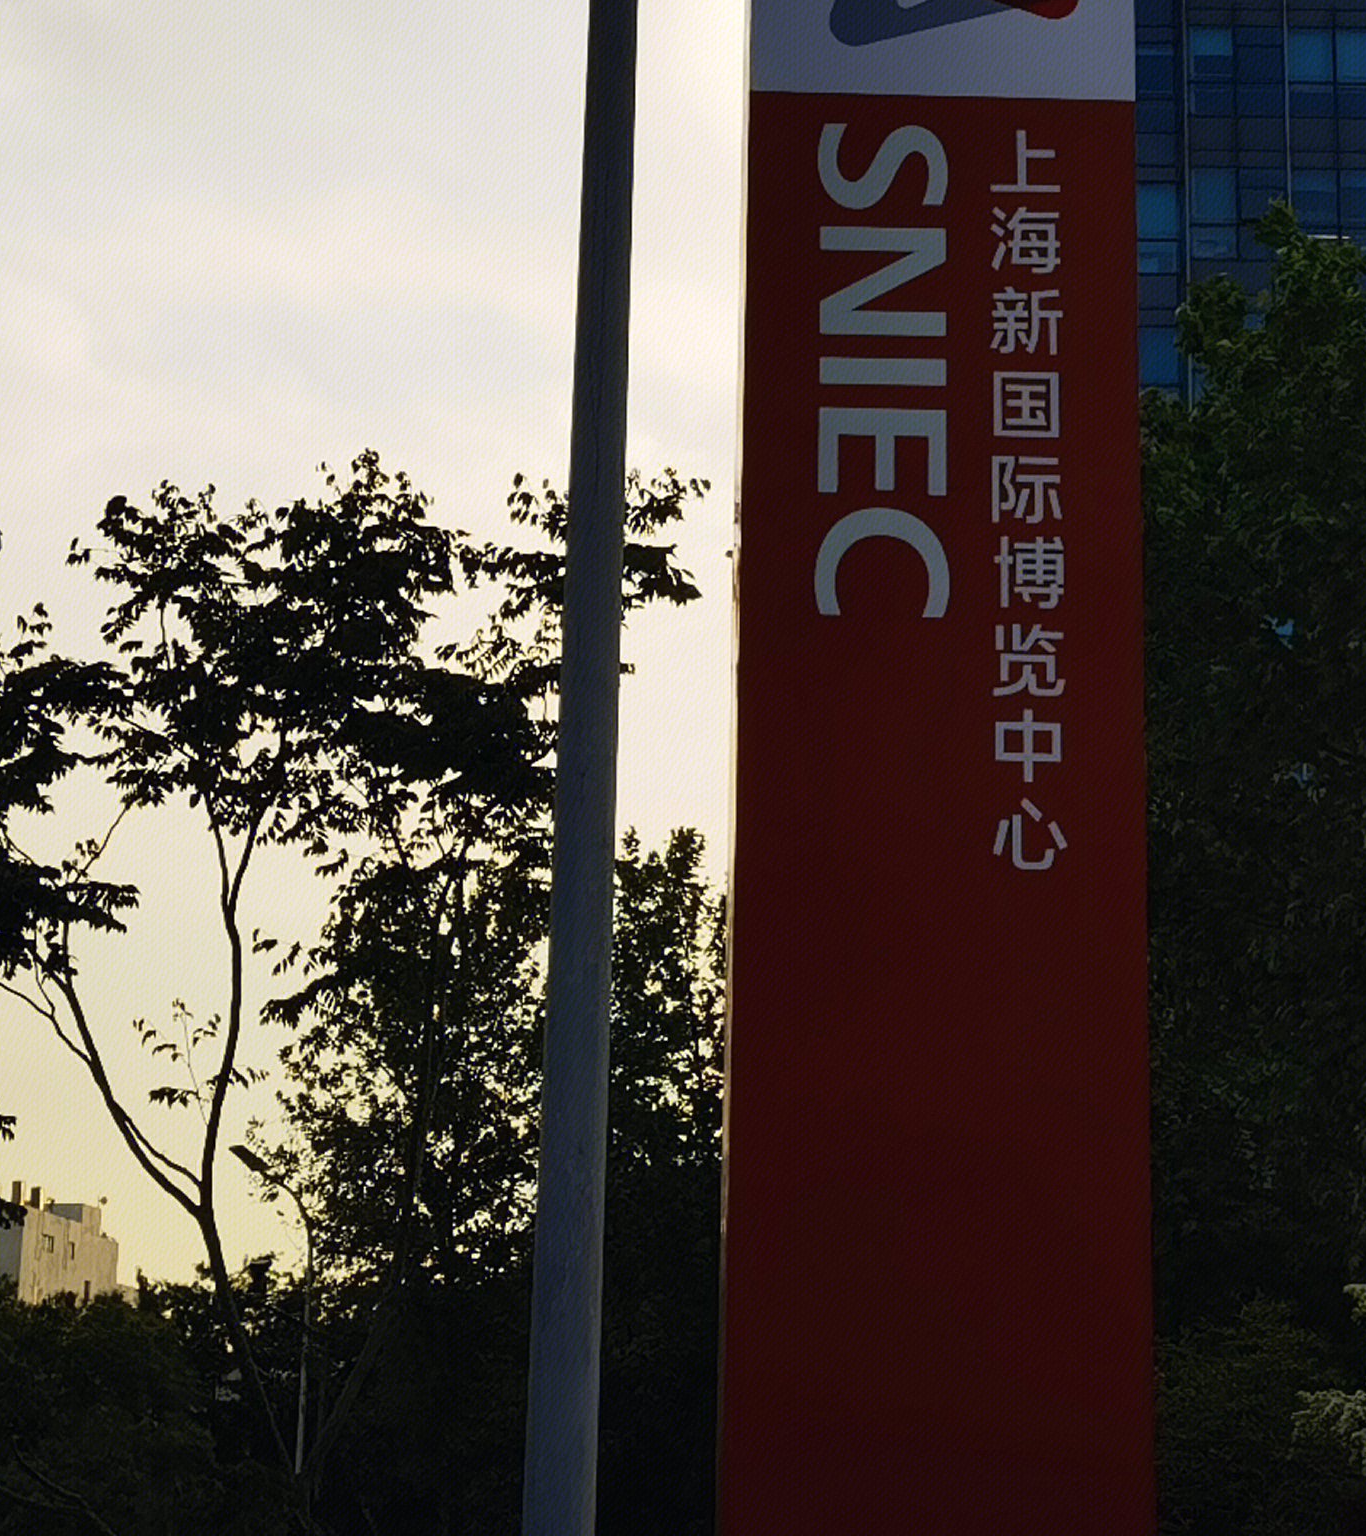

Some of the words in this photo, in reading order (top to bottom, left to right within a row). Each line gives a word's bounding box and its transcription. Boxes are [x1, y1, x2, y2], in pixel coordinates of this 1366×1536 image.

[815, 124, 950, 619] SNIEC
[990, 130, 1068, 871] 上海新国际博览中心
